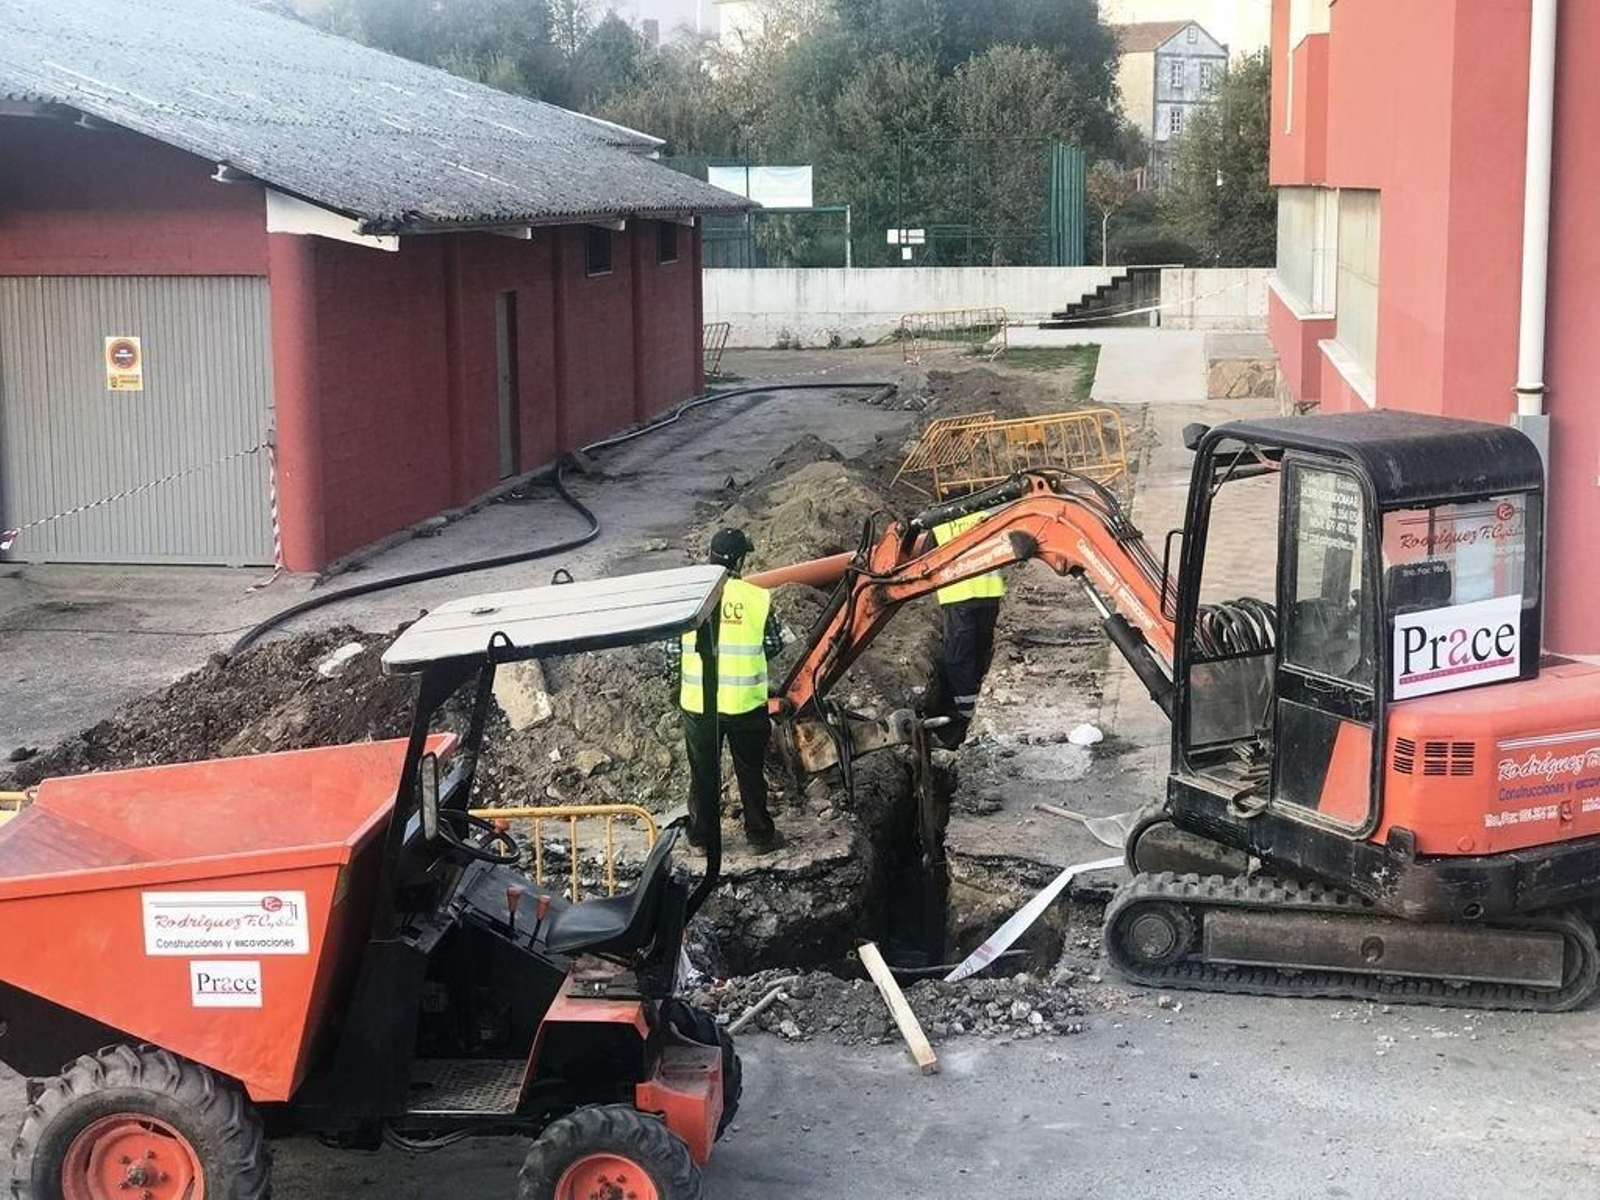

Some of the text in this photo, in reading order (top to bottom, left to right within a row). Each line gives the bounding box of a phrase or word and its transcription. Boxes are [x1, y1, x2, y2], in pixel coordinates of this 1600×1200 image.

[1400, 623, 1515, 676] Prace
[1499, 783, 1565, 801] Construcciones
[156, 938, 294, 949] Construcciones y excavaciones
[197, 973, 257, 992] Prace
